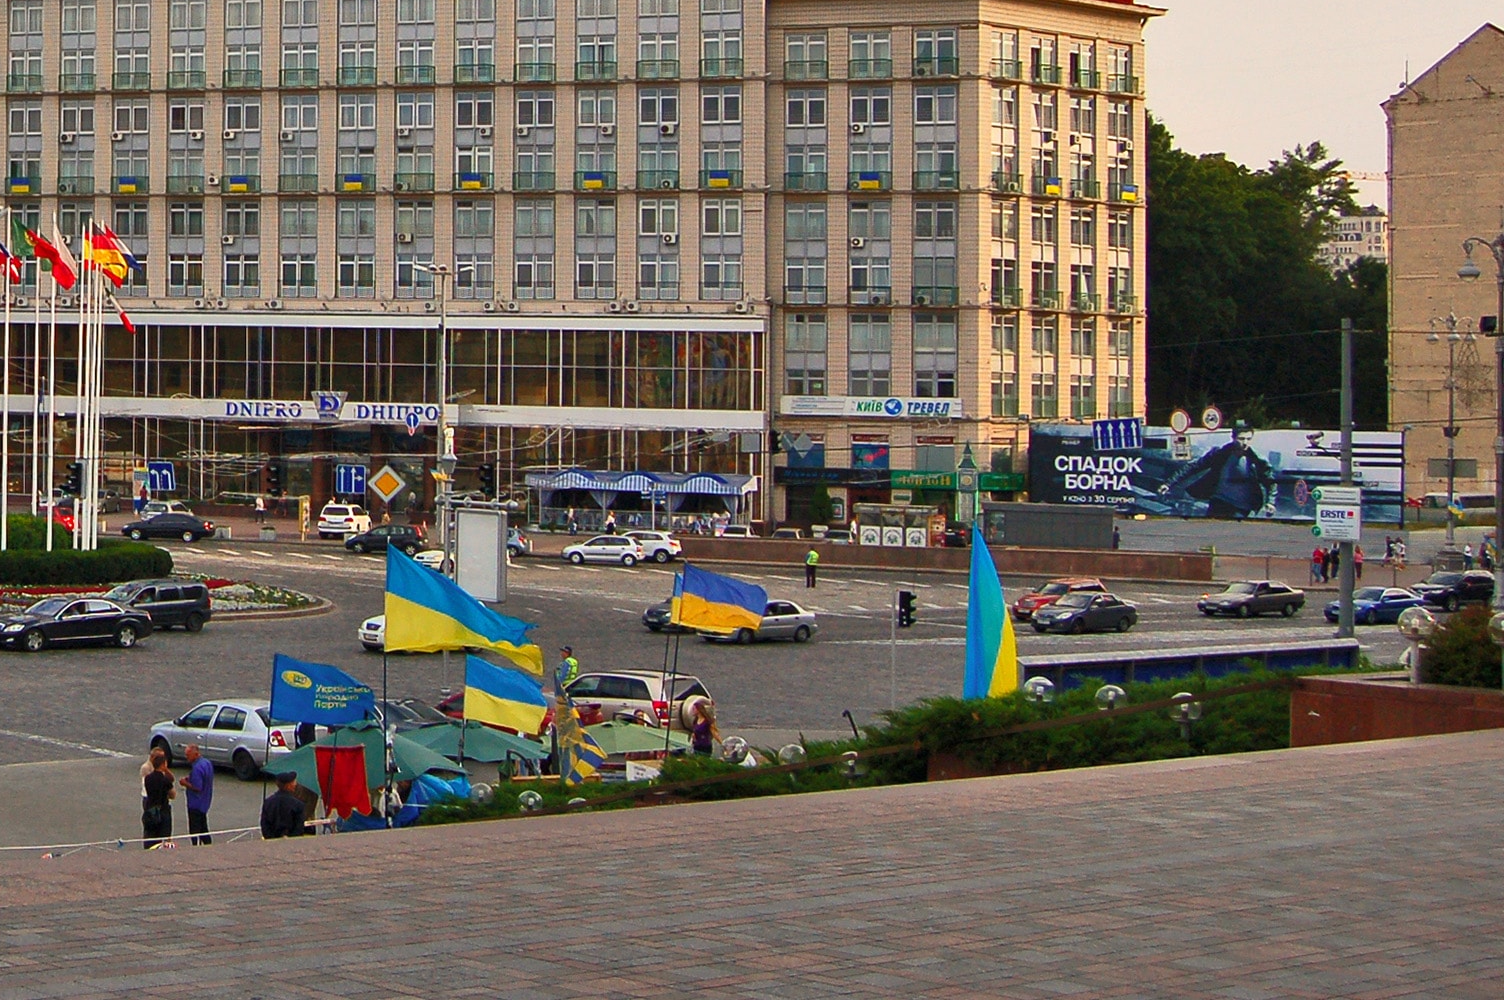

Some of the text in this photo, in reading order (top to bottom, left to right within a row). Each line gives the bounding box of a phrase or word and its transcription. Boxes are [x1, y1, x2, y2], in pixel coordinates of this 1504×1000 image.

[226, 401, 303, 418] DNIPRO
[907, 402, 950, 414] ТРЕВЕЛ
[1054, 455, 1143, 474] СПАДОК
[1064, 474, 1132, 490] БОРНА
[1094, 494, 1105, 503] 30
[1320, 510, 1346, 519] ERSTE
